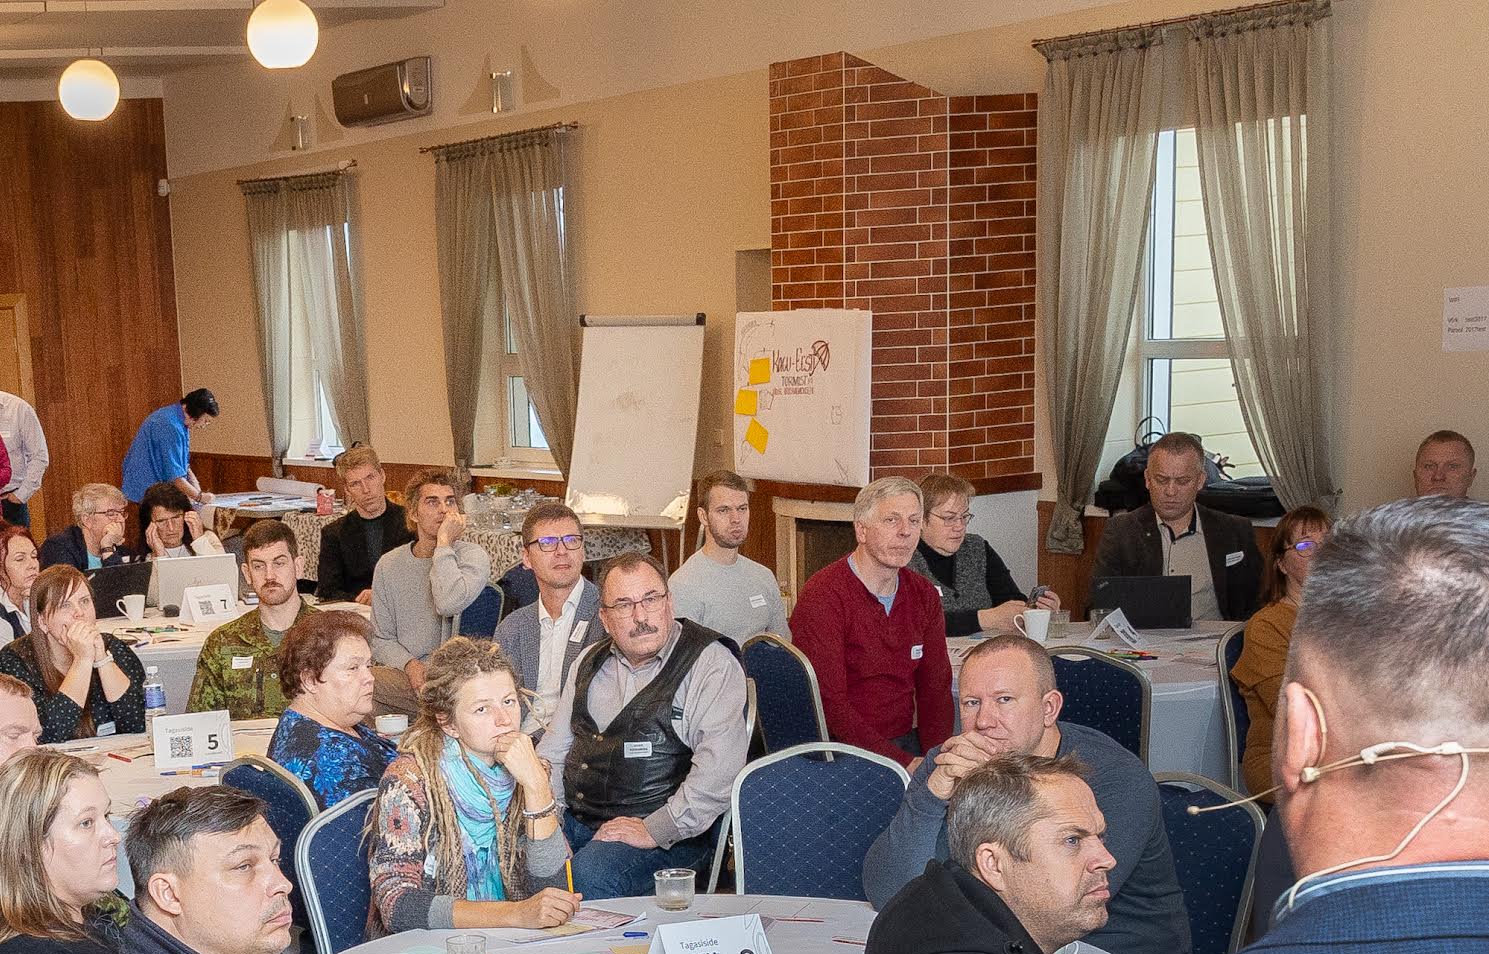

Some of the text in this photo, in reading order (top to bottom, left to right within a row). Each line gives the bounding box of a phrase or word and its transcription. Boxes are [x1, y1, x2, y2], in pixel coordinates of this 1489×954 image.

[220, 599, 227, 609] 7
[207, 734, 219, 750] 5
[679, 938, 719, 951] Tagasiside
